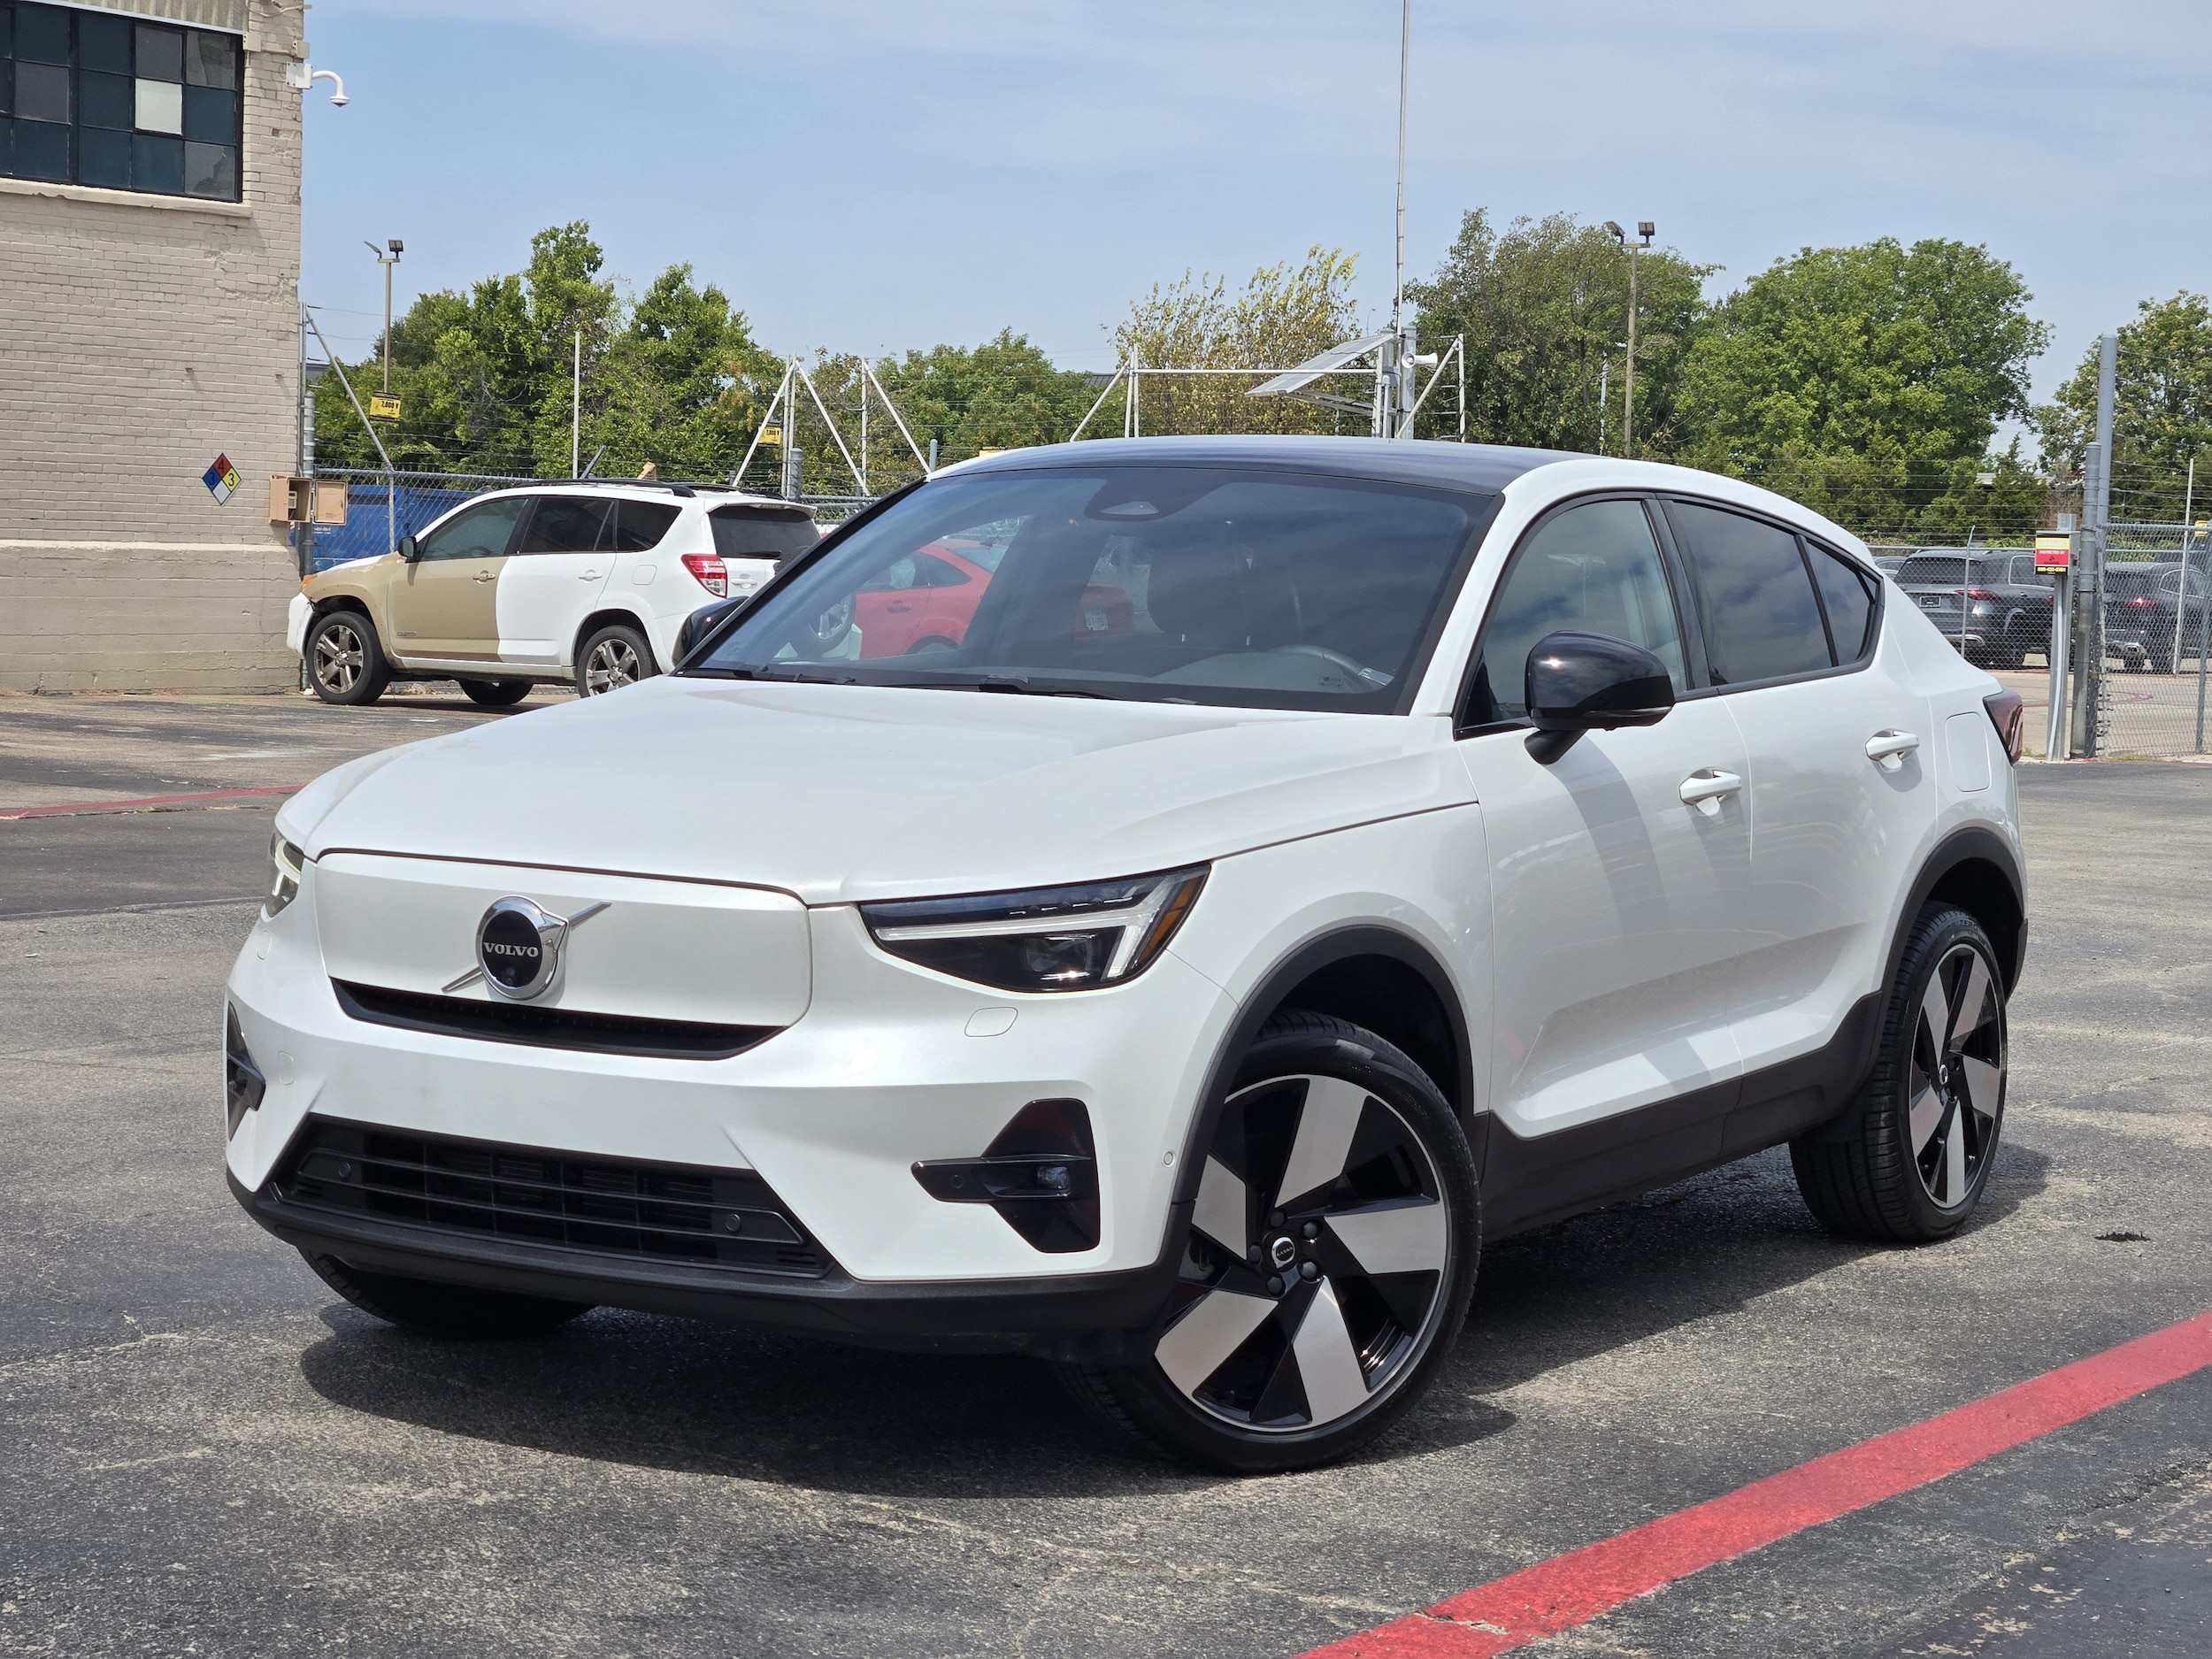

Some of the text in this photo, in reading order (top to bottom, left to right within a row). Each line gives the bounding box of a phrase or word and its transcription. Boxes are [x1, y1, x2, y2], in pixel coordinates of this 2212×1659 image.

[218, 458, 225, 473] 4
[208, 472, 234, 487] 3 3
[1959, 919, 1978, 932] ZERO
[483, 941, 539, 957] VOLVO
